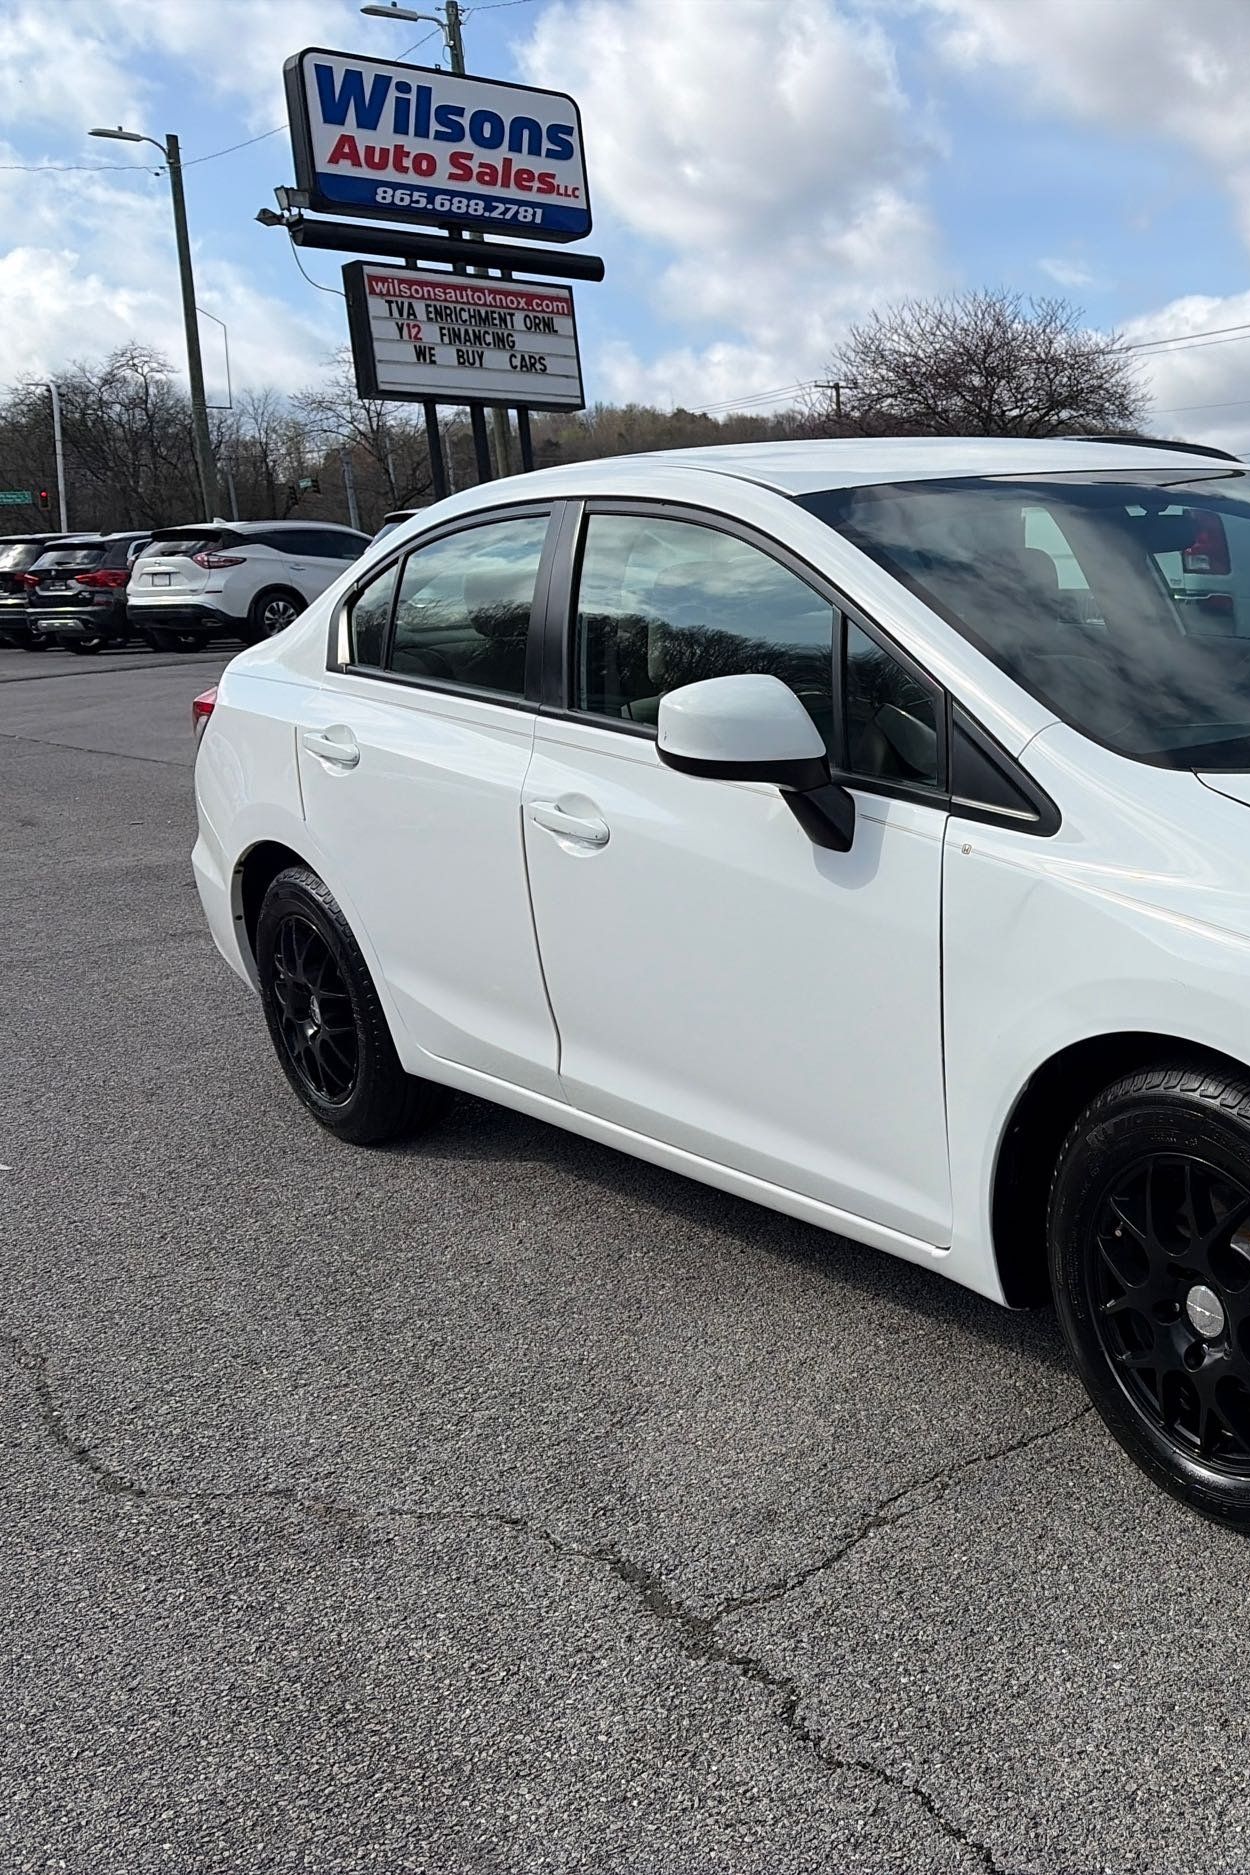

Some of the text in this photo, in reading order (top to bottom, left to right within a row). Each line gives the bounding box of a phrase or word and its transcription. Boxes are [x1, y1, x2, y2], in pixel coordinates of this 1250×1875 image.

[314, 63, 574, 161] Wilsons
[327, 134, 580, 199] Auto Sales LLC
[375, 186, 543, 224] 865.688.2781
[371, 278, 568, 314] wilsonsautoknox.com
[385, 299, 558, 333] TVA ENRICHMENT ORNL
[395, 322, 516, 350] Y12 FINANCING
[413, 344, 547, 373] WE BUY CARS
